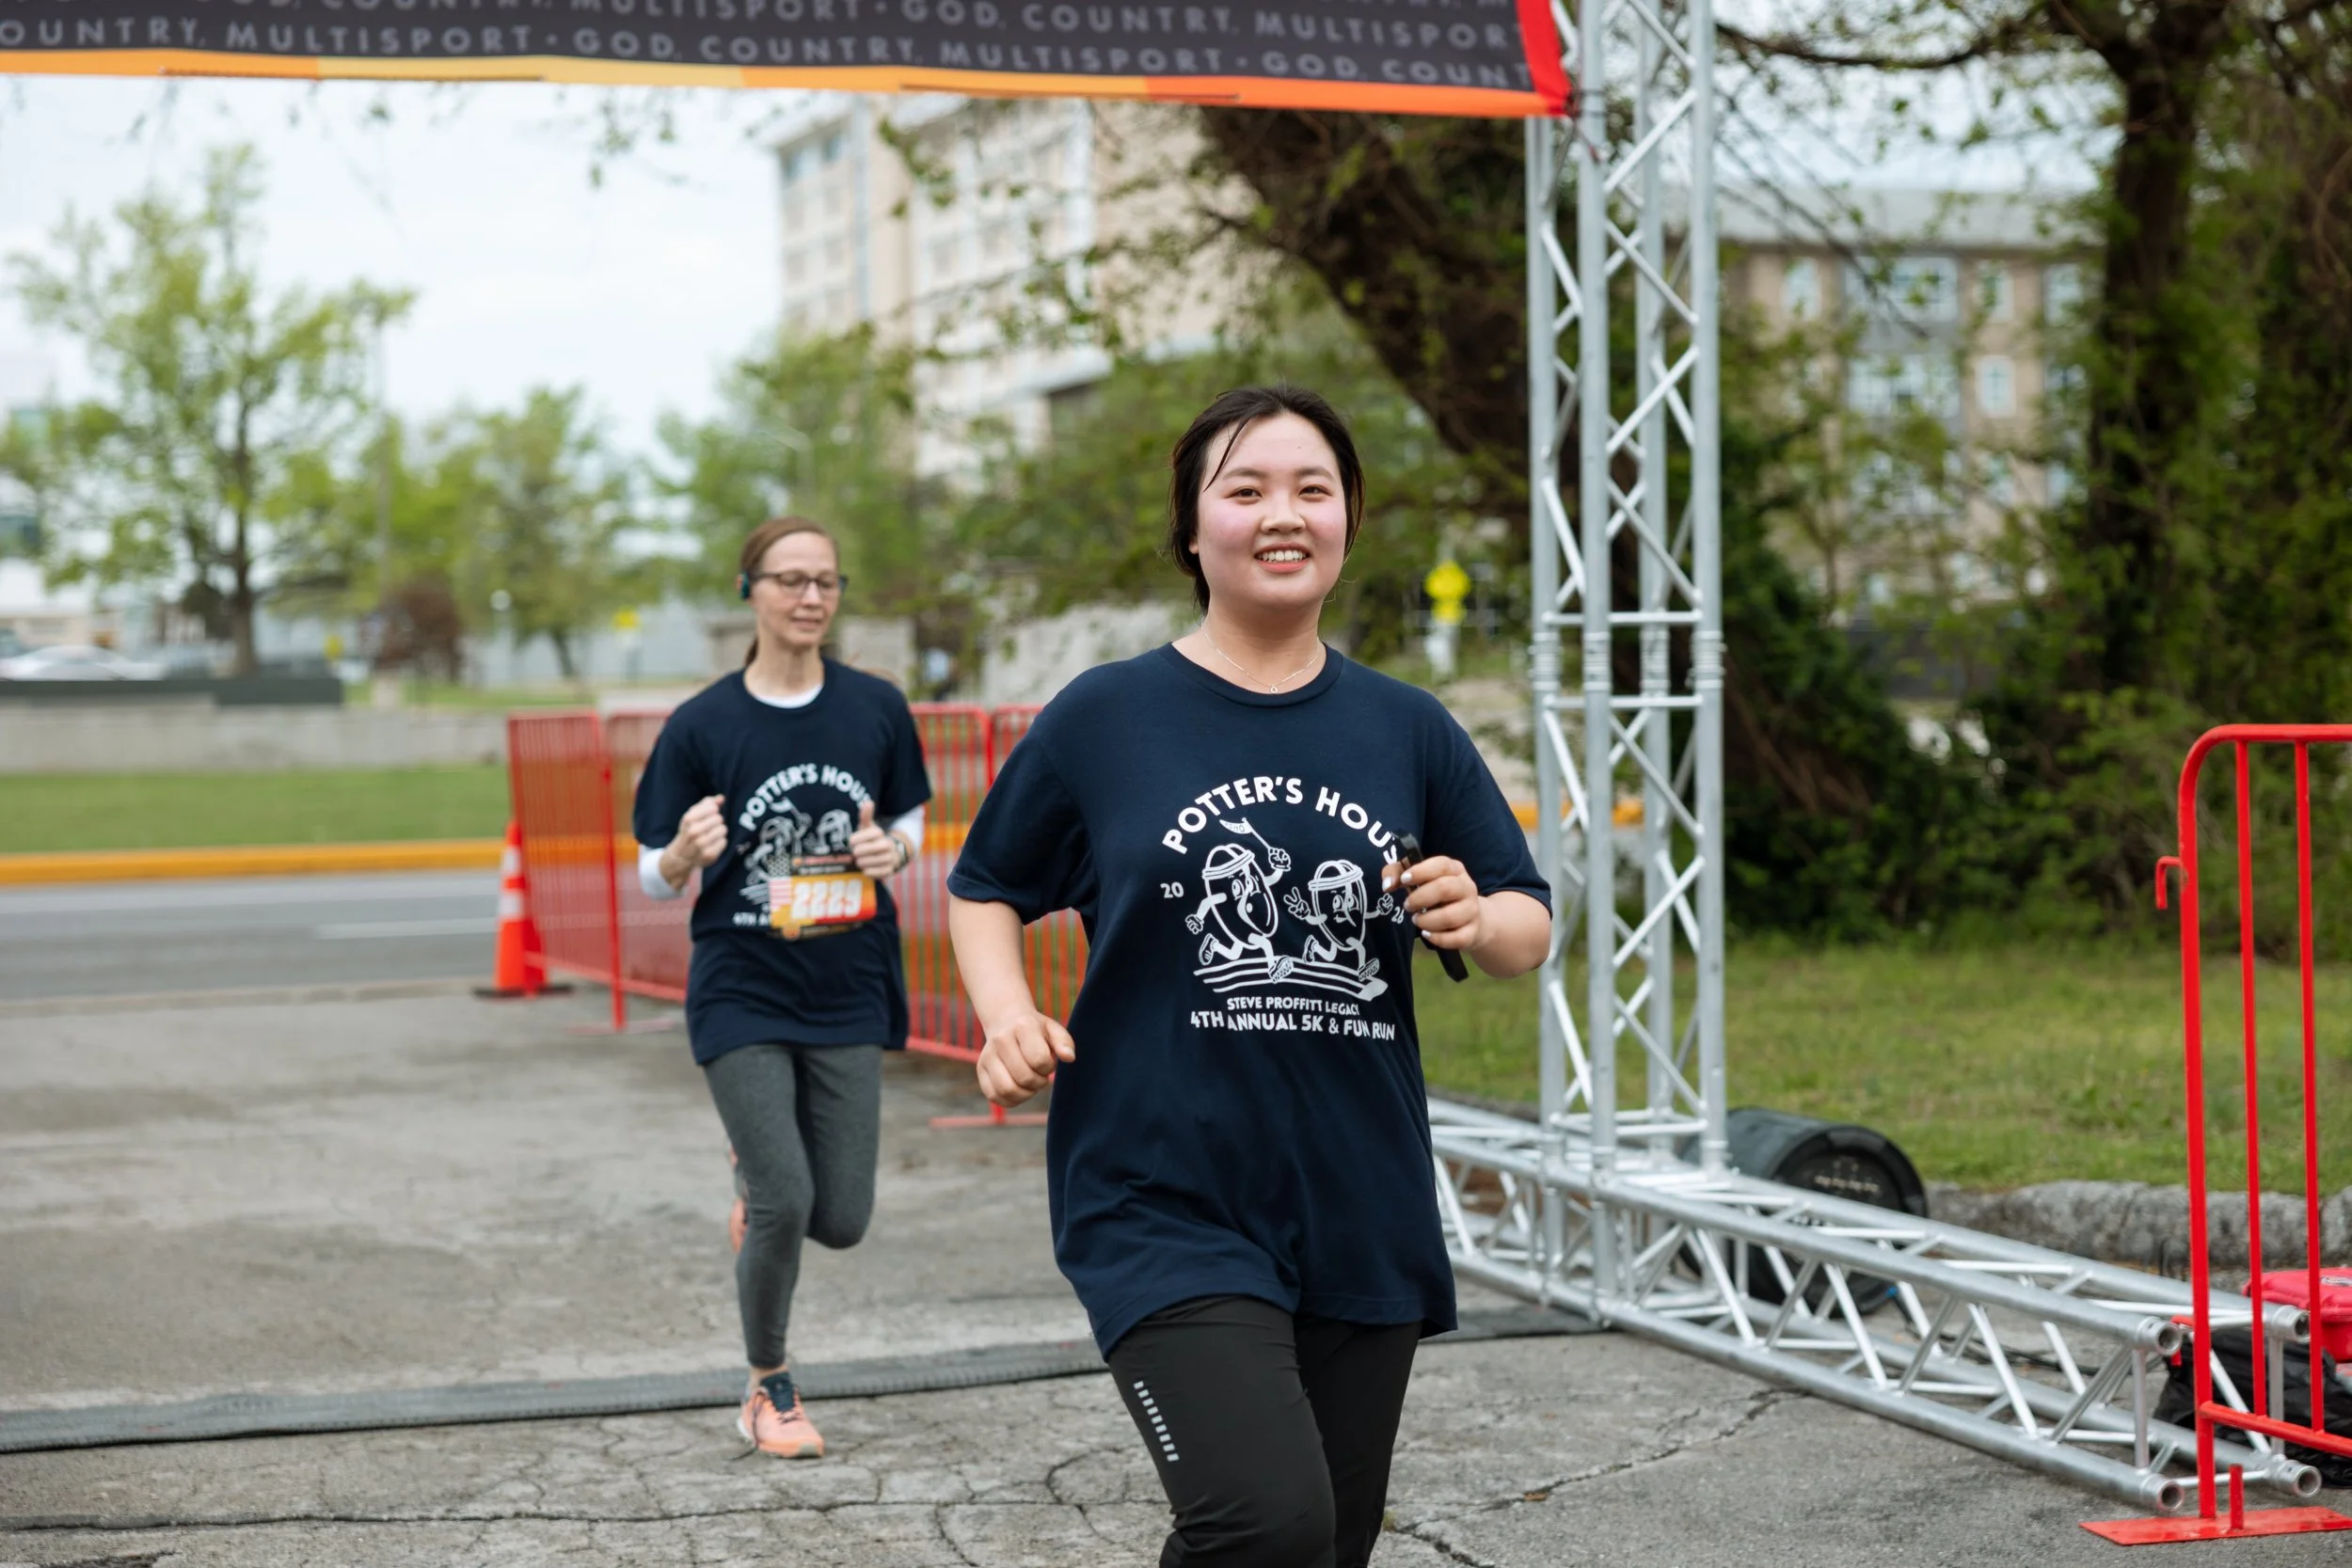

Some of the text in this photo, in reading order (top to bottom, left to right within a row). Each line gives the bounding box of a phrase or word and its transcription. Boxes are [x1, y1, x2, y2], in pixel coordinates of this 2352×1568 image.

[1022, 4, 1240, 35] COUNTRY,
[226, 20, 532, 55] MULTISPORT
[572, 27, 682, 61] GOD,
[699, 35, 924, 63] COUNTRY,
[941, 40, 1222, 72] MULTISPORT
[739, 763, 818, 832] POTTER'S
[1162, 776, 1304, 854] POTTER'S
[1160, 881, 1184, 899] 20
[1227, 996, 1263, 1010] STEVE
[1265, 996, 1323, 1012] PROFFITT
[1190, 1010, 1395, 1040] 4TH ANNUAL 5K & FUN RUN
